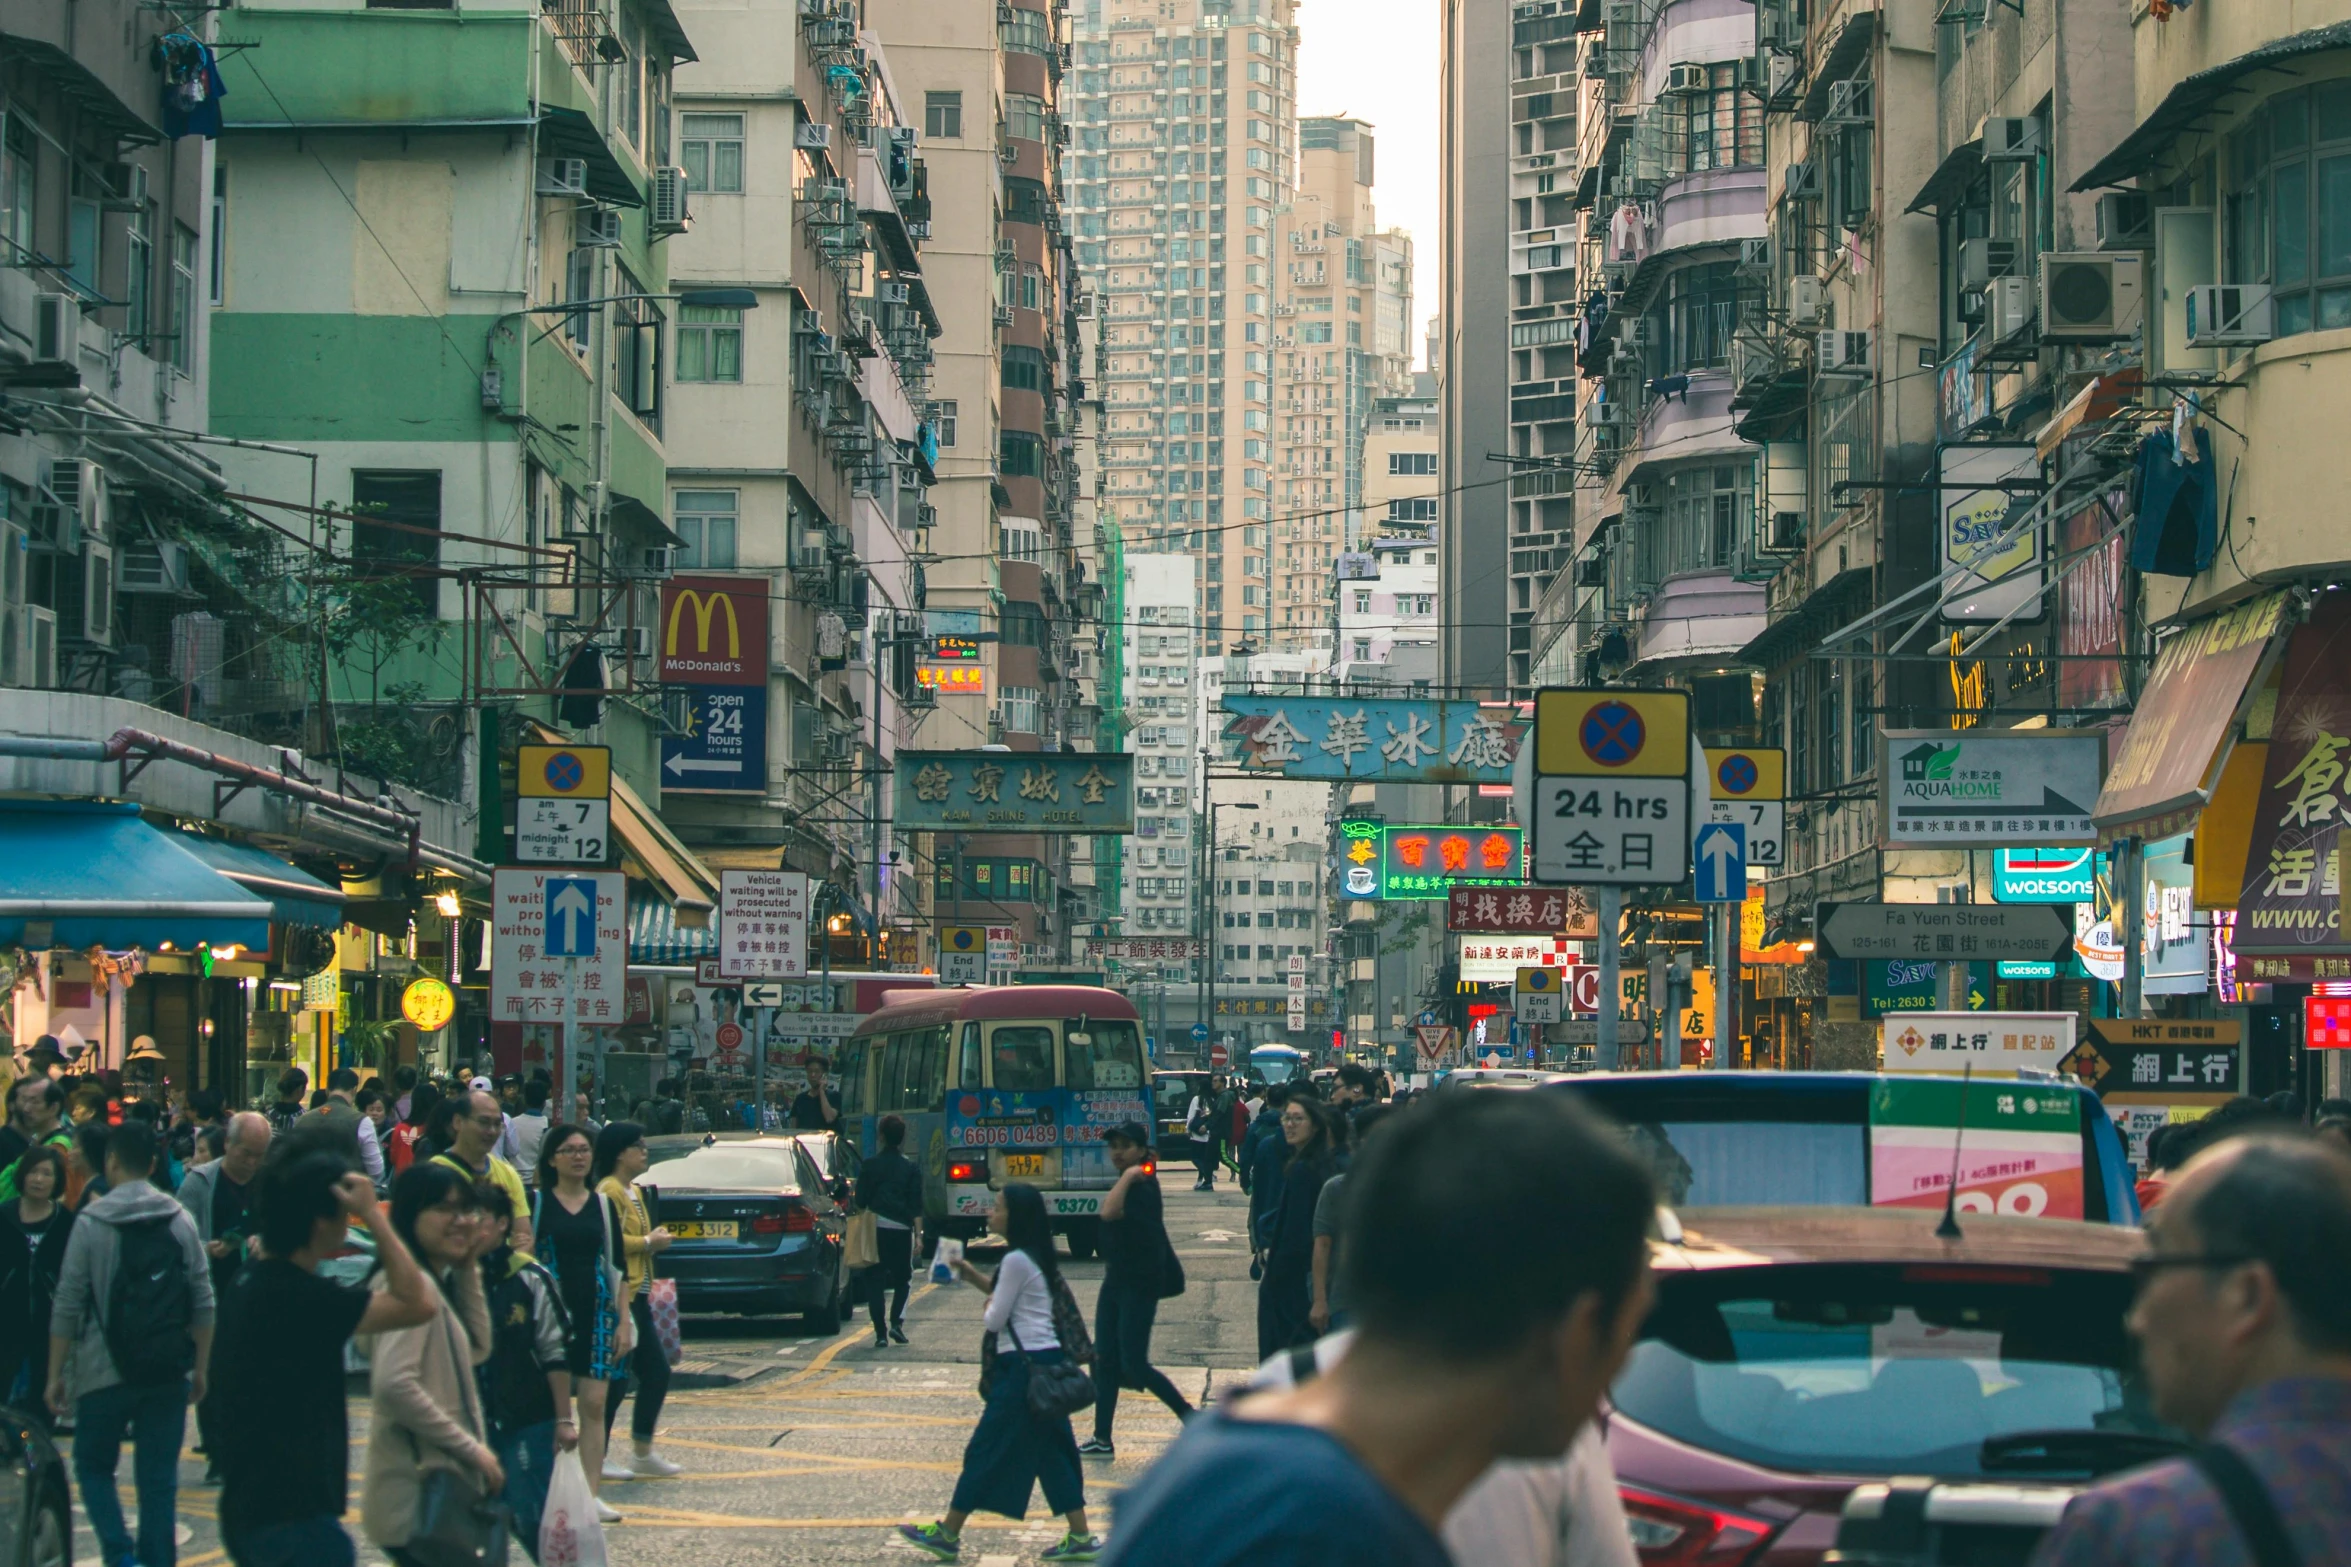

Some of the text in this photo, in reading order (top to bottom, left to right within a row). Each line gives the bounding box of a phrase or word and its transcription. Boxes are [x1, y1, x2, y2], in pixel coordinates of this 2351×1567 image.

[666, 659, 742, 673] McDonald's
[707, 708, 744, 735] 24
[707, 733, 743, 746] hours
[1251, 707, 1514, 768] 金華冰廳
[1903, 782, 2002, 801] AQUAHOME
[539, 800, 555, 809] am
[1554, 789, 1668, 820] 24 hrs
[1712, 803, 1729, 812] am
[532, 810, 560, 824] 上午
[575, 803, 591, 825] 7
[942, 809, 1084, 823] KAM SHING HOTEL
[1749, 805, 1765, 826] 7
[521, 832, 570, 846] midnight
[531, 845, 559, 858] 午夜
[574, 838, 601, 859] 12
[1564, 829, 1653, 871] 全日
[1750, 839, 1777, 861] 12
[747, 874, 782, 886] Vehicle
[2004, 879, 2095, 895] watsons
[508, 891, 545, 905] waiti
[730, 885, 798, 897] waiting will be
[737, 896, 791, 909] prosecuted
[724, 907, 803, 920] without warning
[1473, 893, 1567, 927] 找換店
[1886, 910, 2005, 926] Fa Yuen Street
[499, 924, 545, 937] witho
[737, 922, 791, 936] 停車等候
[737, 940, 791, 954] 會被檢控
[1851, 937, 1898, 949] 125-161
[1912, 934, 1979, 953] 花園街
[1984, 938, 2050, 950] 161A-205E
[729, 958, 797, 972] 而不予警告
[953, 955, 973, 965] End
[949, 967, 976, 980] 終止
[2003, 965, 2051, 976] watsons
[517, 969, 602, 990] 會被控
[1529, 996, 1549, 1006] End
[1524, 1008, 1552, 1021] 終止
[2131, 1025, 2164, 1039] HKT
[964, 1124, 1058, 1146] 6606 0489
[694, 1223, 734, 1237] 3312
